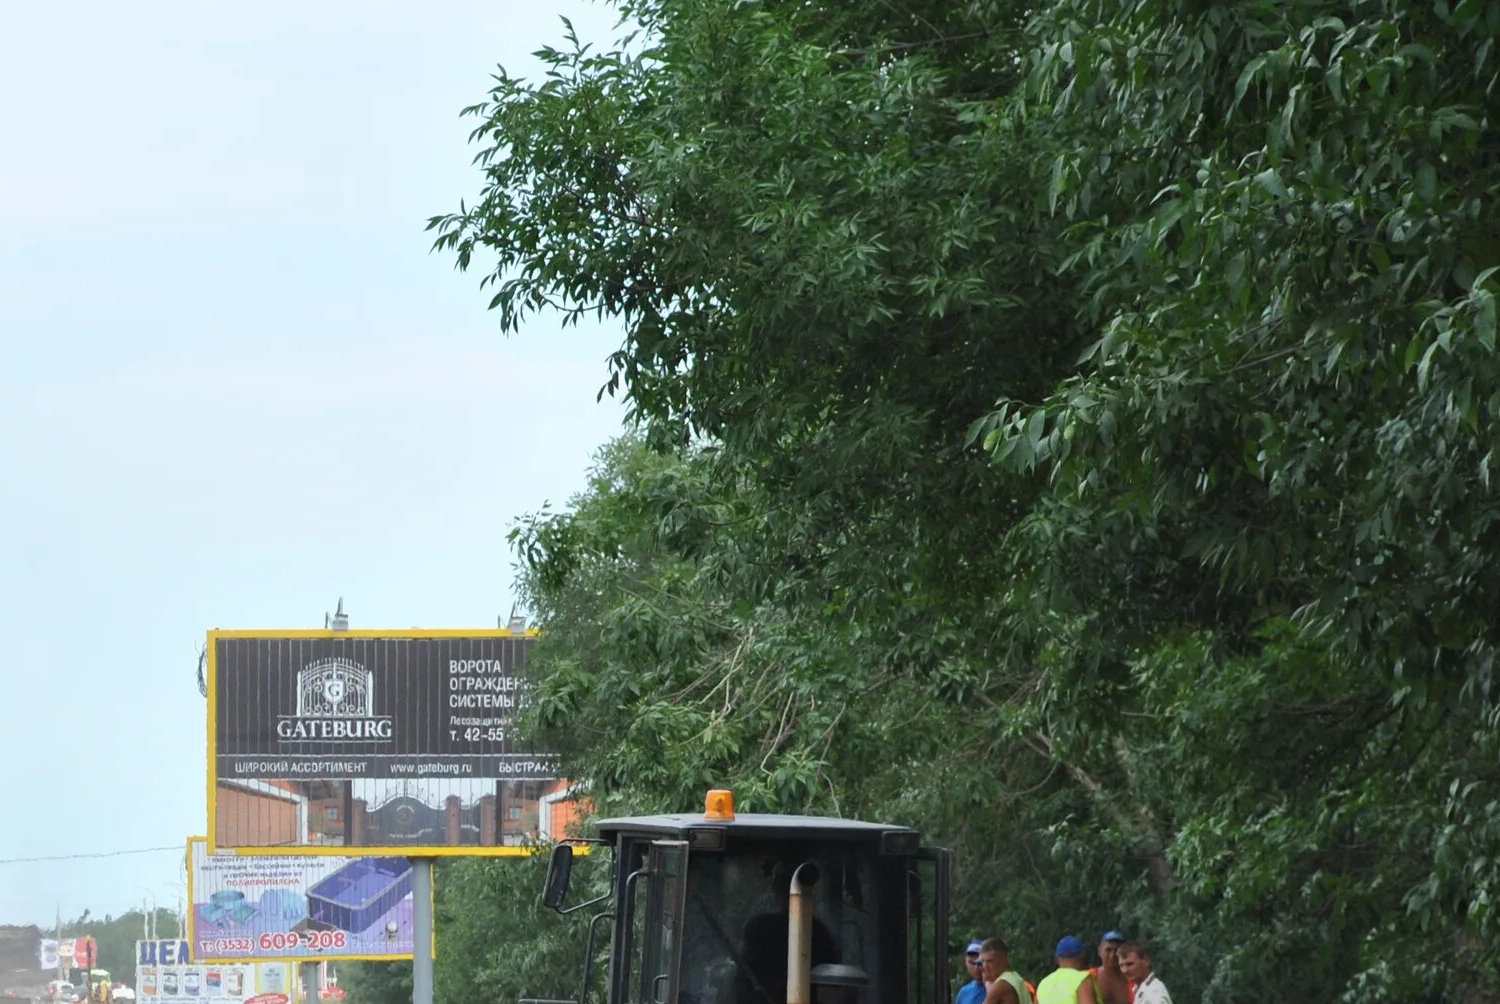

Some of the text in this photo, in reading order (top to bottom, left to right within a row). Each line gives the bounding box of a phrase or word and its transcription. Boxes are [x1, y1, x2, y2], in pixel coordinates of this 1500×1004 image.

[449, 660, 501, 673] ВОРОТА
[328, 684, 340, 697] G
[449, 694, 515, 708] СИСТЕМЫ
[277, 720, 392, 738] GATEBURG
[450, 730, 459, 741] т.
[235, 761, 367, 773] ШИРОКИЙ АССОРТИМЕНТ
[390, 763, 472, 774] www.gateburg.ru
[227, 879, 300, 887] ПОЛИПРОПИЛЕНА
[215, 938, 255, 953] (3532)
[259, 932, 346, 950] 609-208
